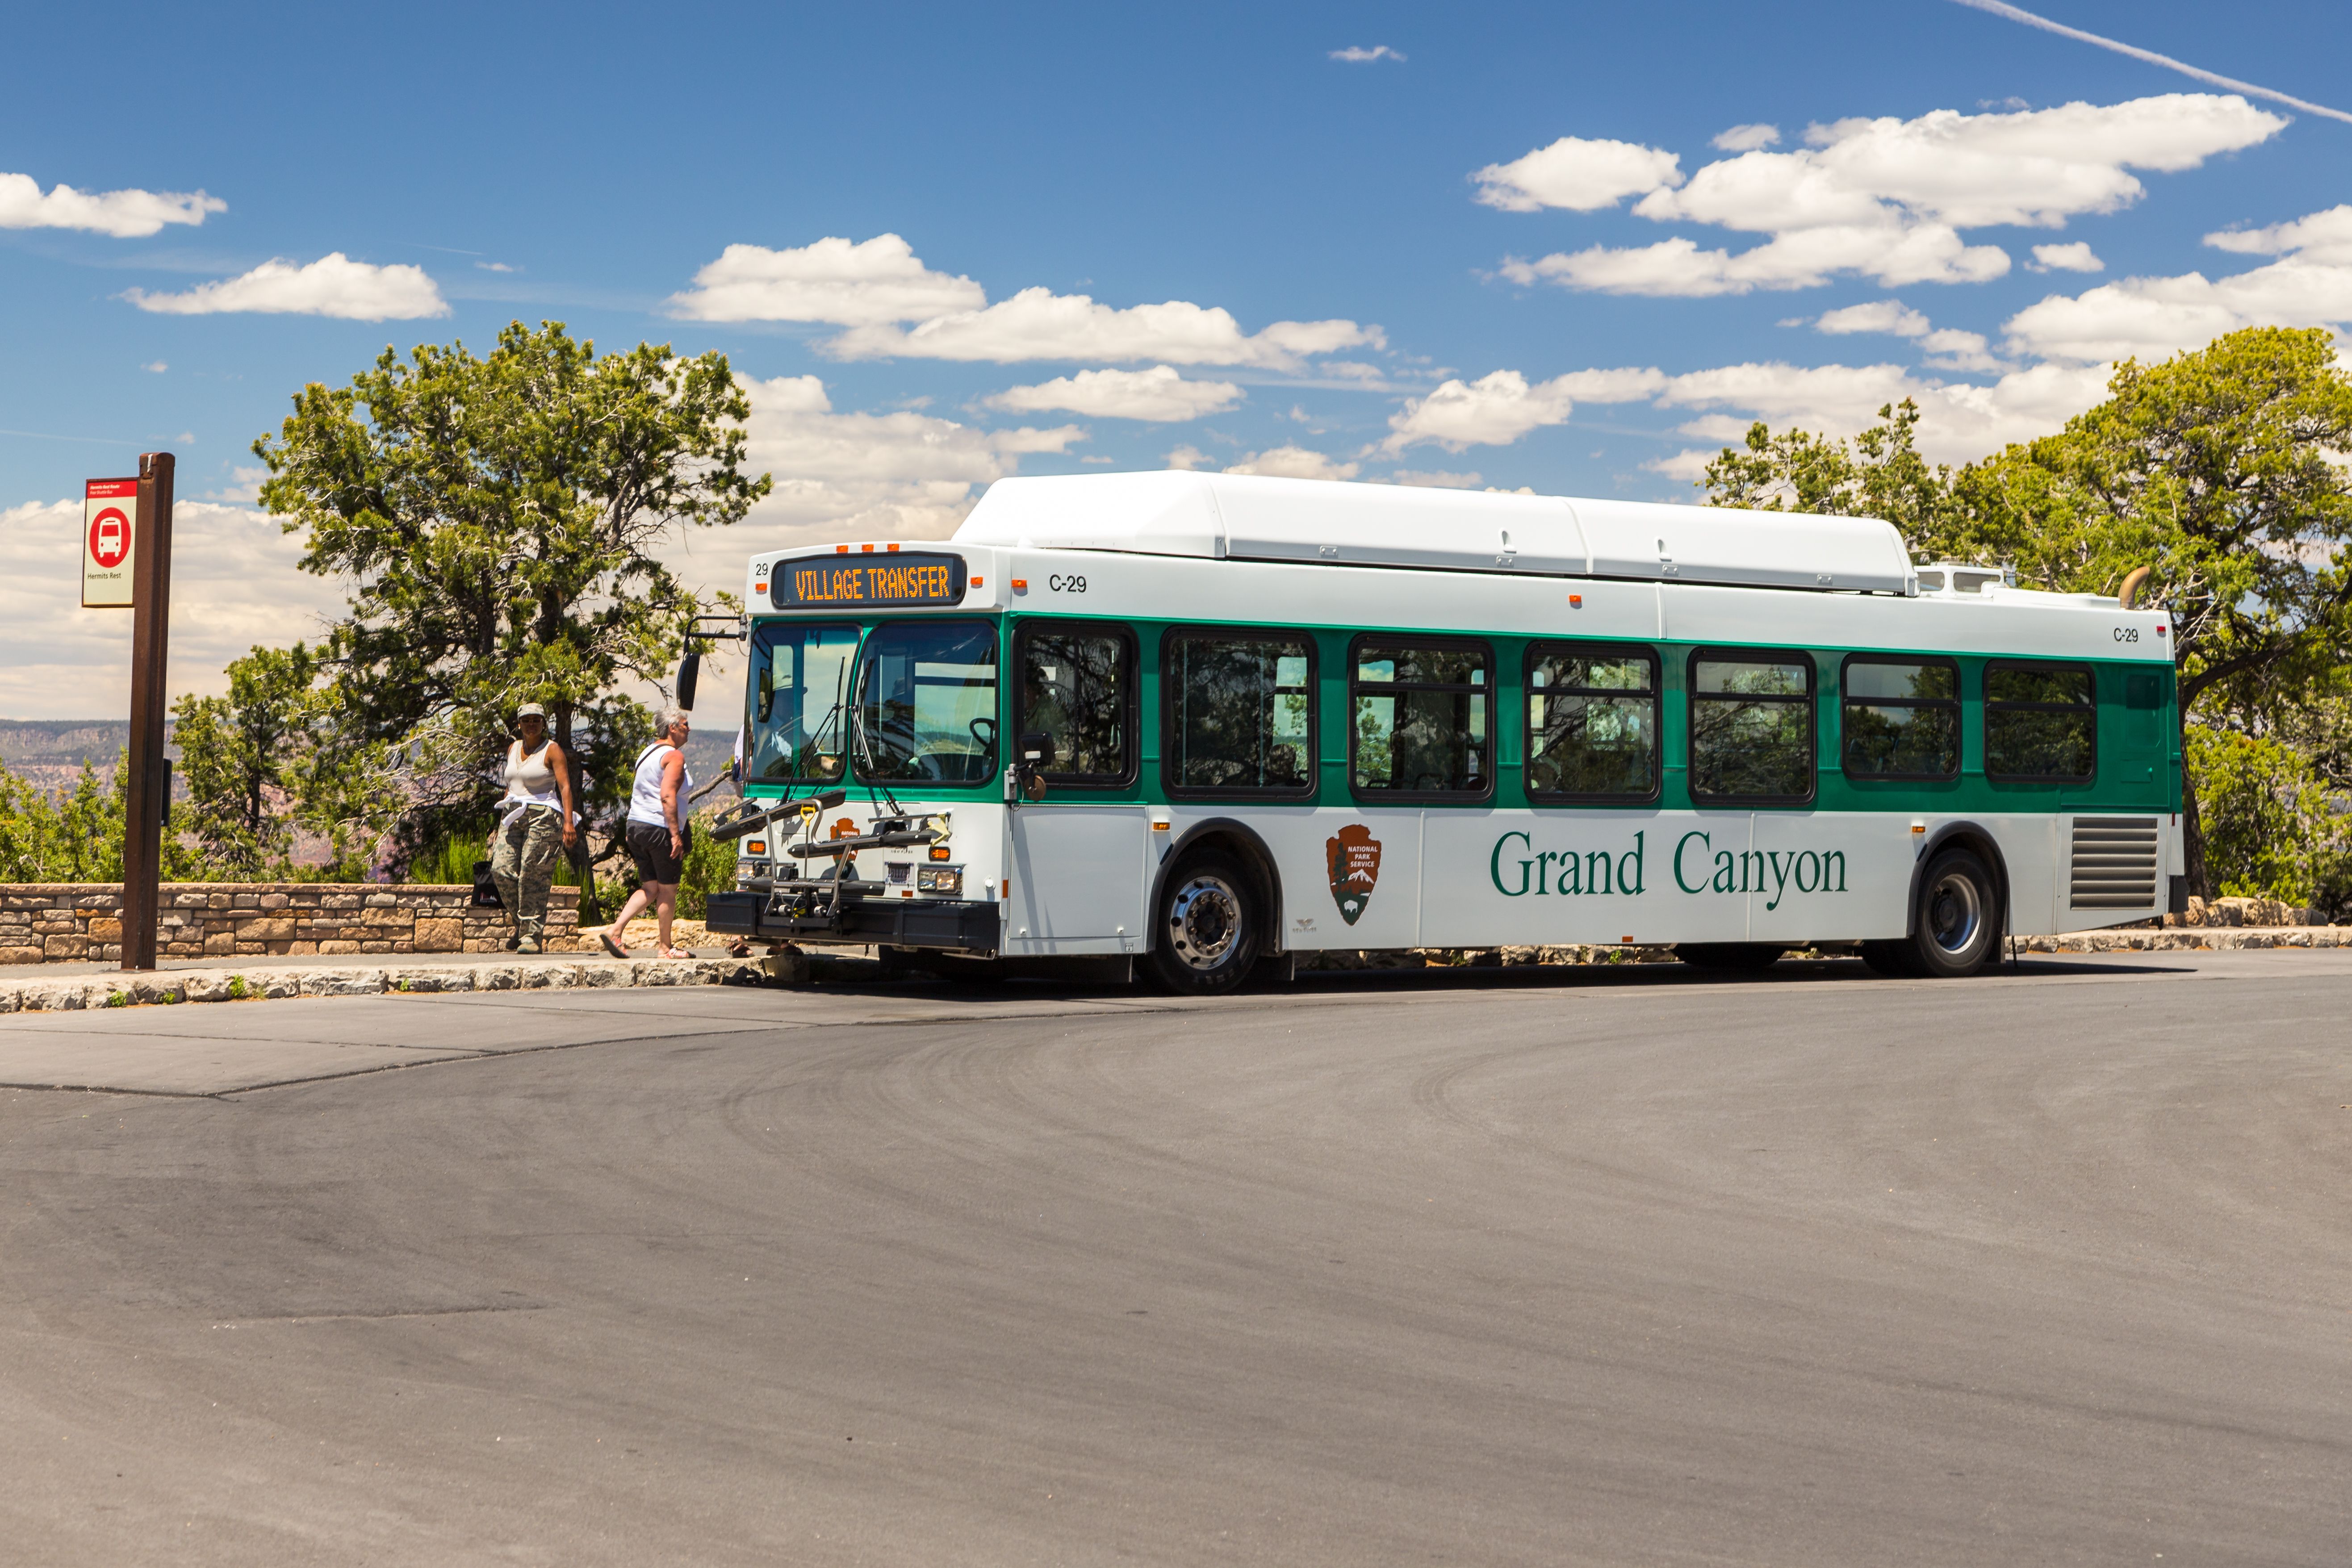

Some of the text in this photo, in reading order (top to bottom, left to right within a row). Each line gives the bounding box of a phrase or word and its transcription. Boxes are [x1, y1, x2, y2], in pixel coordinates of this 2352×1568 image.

[756, 563, 768, 576] 29
[795, 566, 950, 600] VILLAGE TRANSFER
[1050, 574, 1087, 593] C-29
[2113, 627, 2139, 642] C-29
[1490, 830, 1849, 911] Grand Canyon
